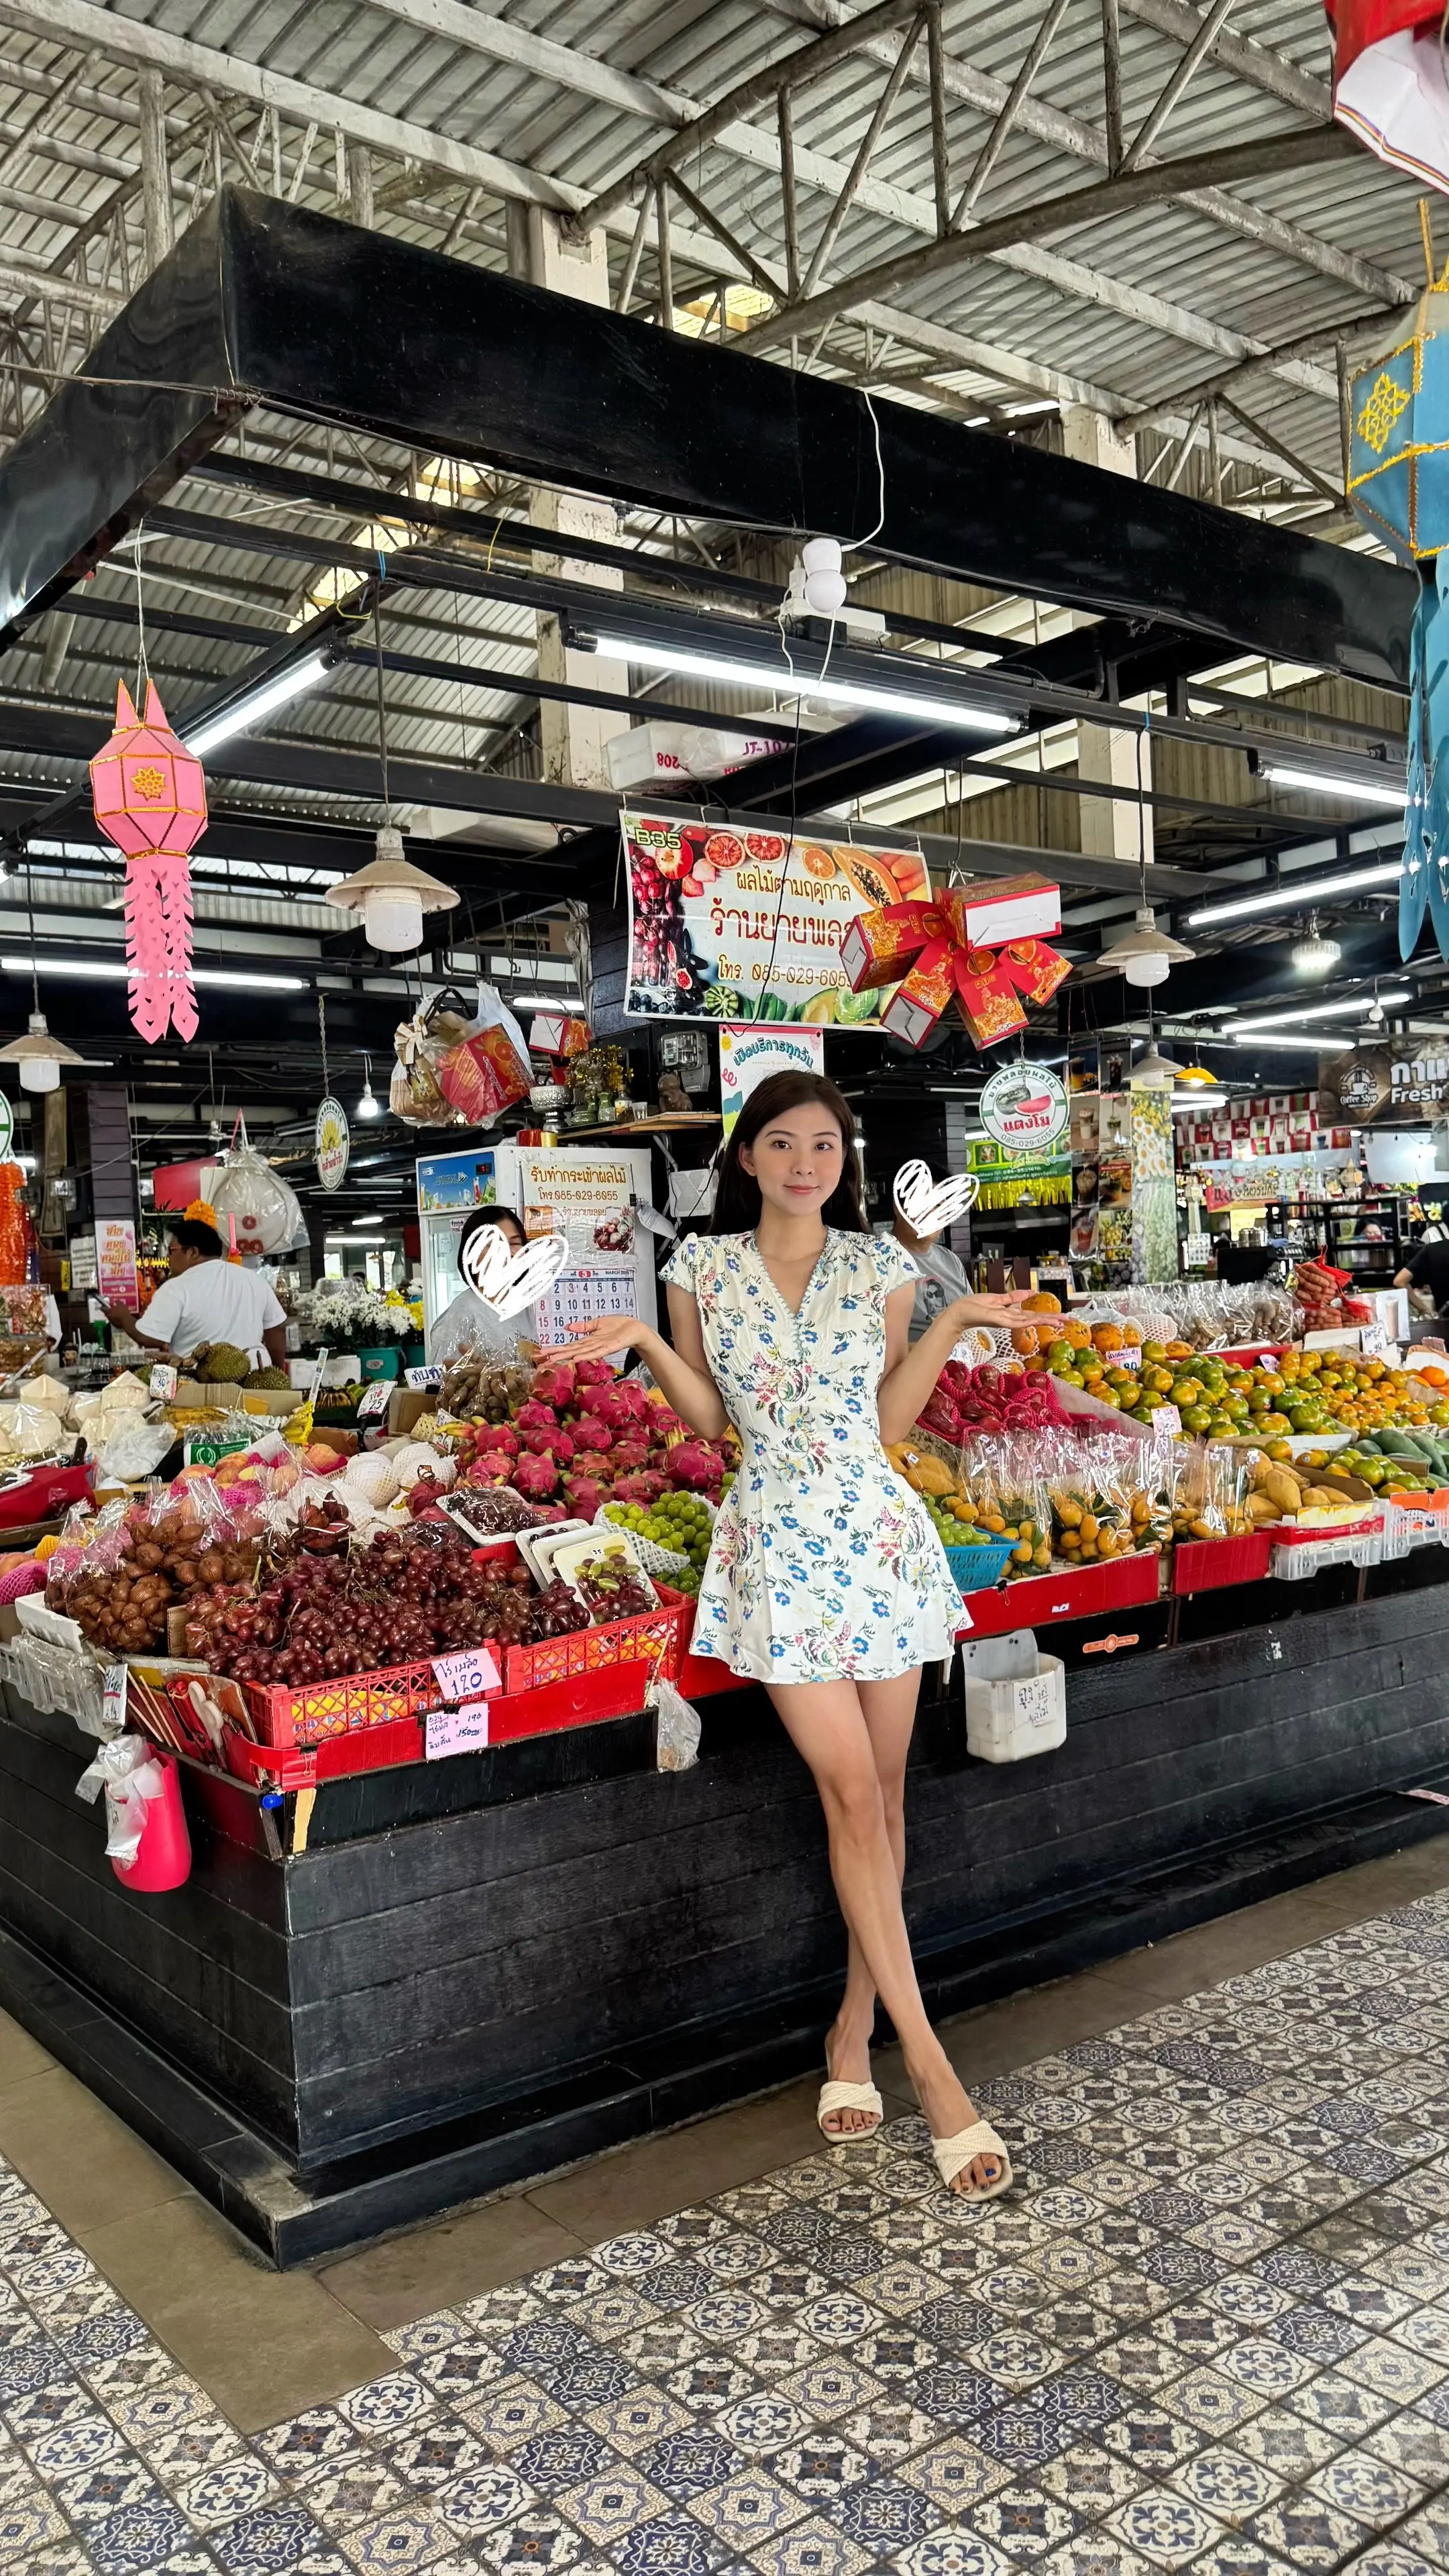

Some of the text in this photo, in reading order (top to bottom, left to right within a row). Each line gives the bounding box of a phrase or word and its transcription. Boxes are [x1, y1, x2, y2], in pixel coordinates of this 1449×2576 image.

[635, 828, 681, 849] B35
[737, 865, 851, 906] ผลไม้ตามฤดูกาล
[752, 963, 851, 987] 085-029-605
[733, 1037, 814, 1069] เปิดบริการทุกวัน
[1390, 1058, 1449, 1085] กาแ
[1340, 1093, 1378, 1106] Coffee Shop
[1391, 1083, 1443, 1104] Fresh
[1003, 1114, 1051, 1132] แตงโม
[1000, 1128, 1055, 1147] 085-029-6055
[554, 1283, 630, 1293] 2 3 4 5 6 7
[540, 1298, 634, 1310] 8 9 10 11 12 13 14
[539, 1318, 549, 1328] 15
[554, 1317, 564, 1327] 16
[539, 1333, 579, 1344] 22 23 24
[451, 1672, 482, 1696] 120
